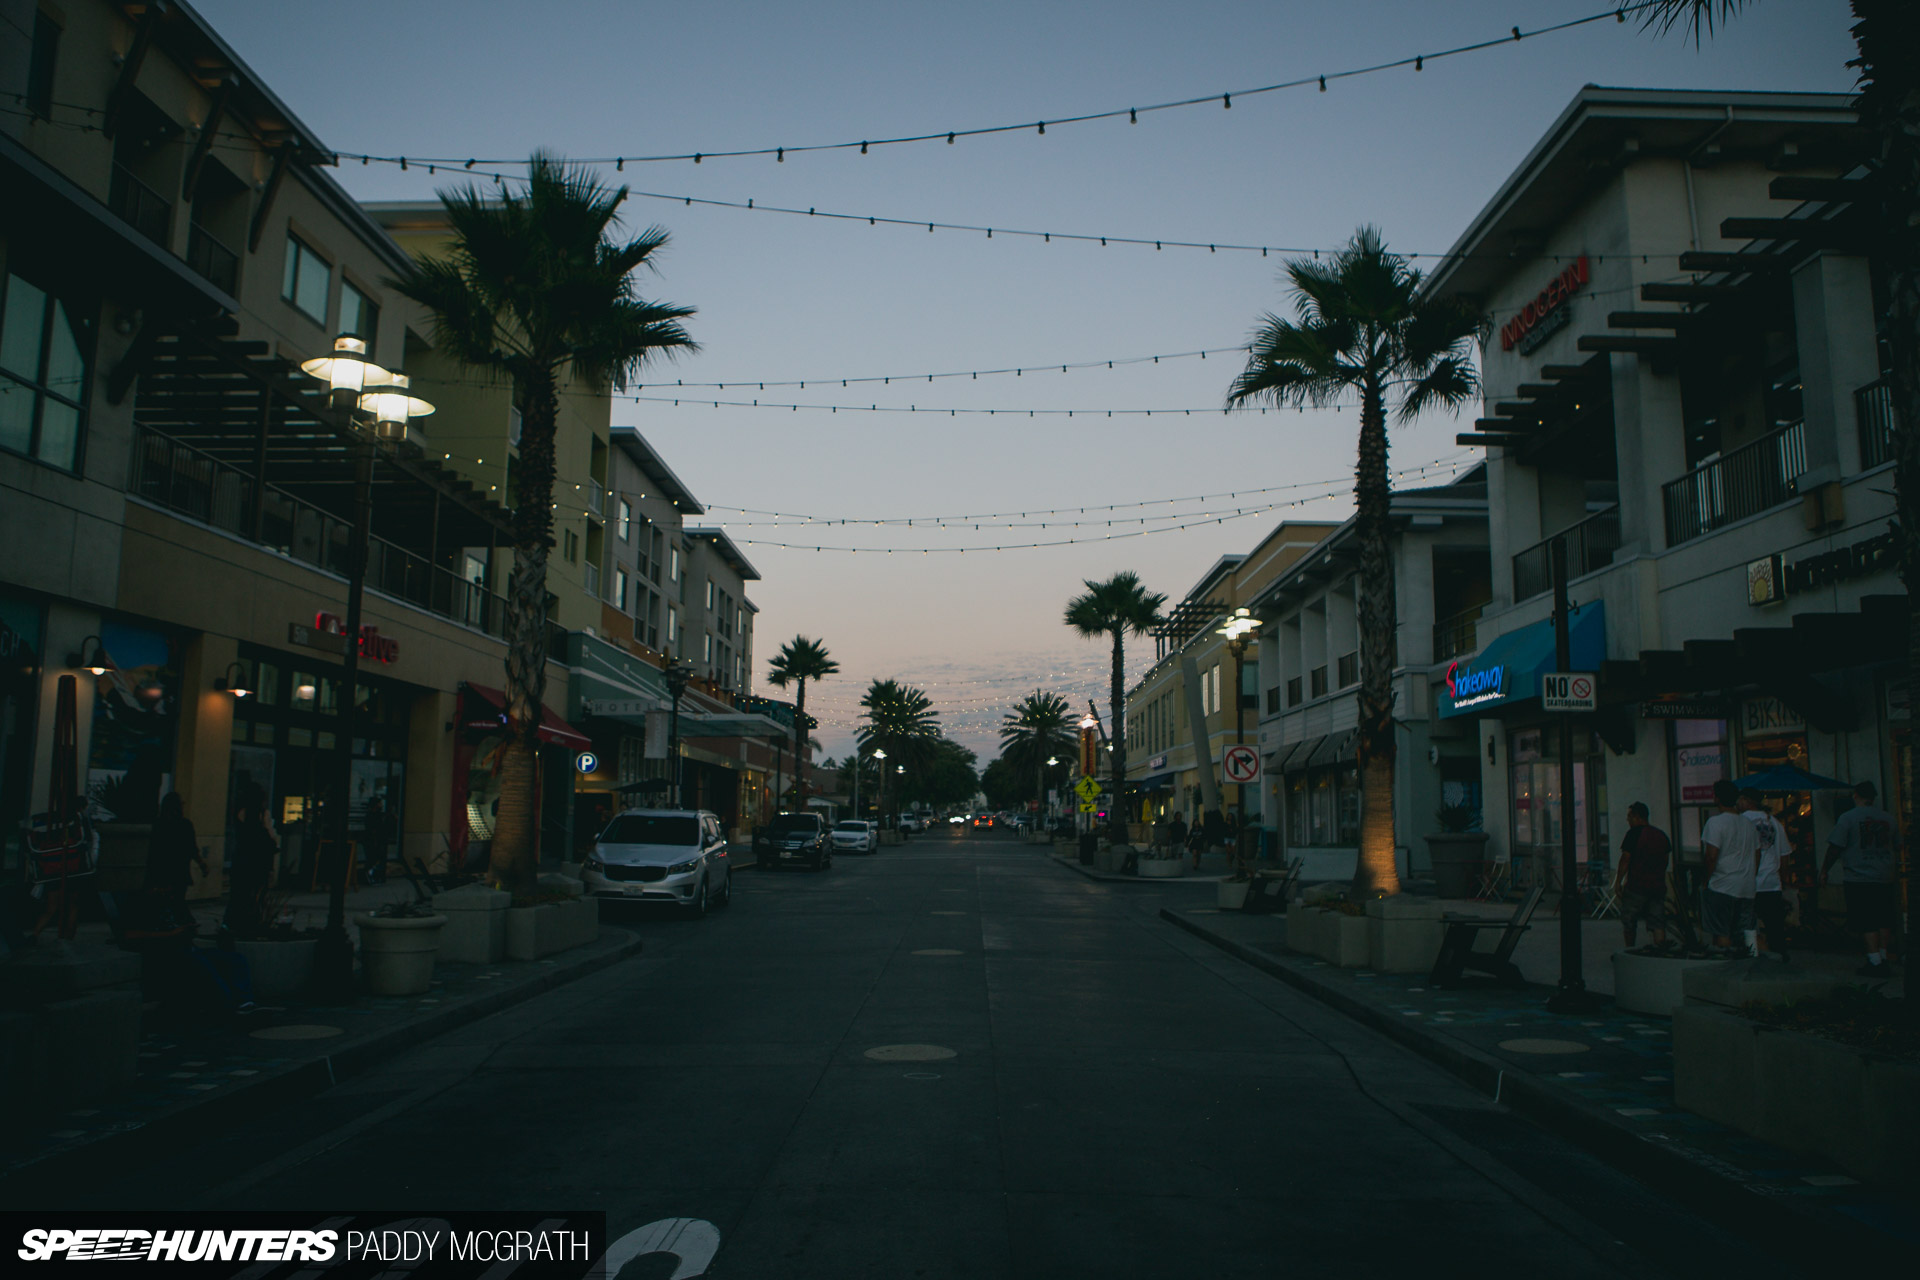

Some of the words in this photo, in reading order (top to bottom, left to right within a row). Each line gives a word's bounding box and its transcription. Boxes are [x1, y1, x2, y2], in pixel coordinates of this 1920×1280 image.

[1502, 256, 1588, 352] INNOCEAN
[1446, 661, 1504, 699] Shakeaway
[1546, 676, 1568, 698] NO
[595, 703, 652, 712] HOTEL
[1546, 699, 1593, 708] SKATEBOARDING
[1653, 704, 1720, 715] SWIMWEAR
[581, 755, 593, 771] P
[1679, 750, 1727, 768] Shakeaway
